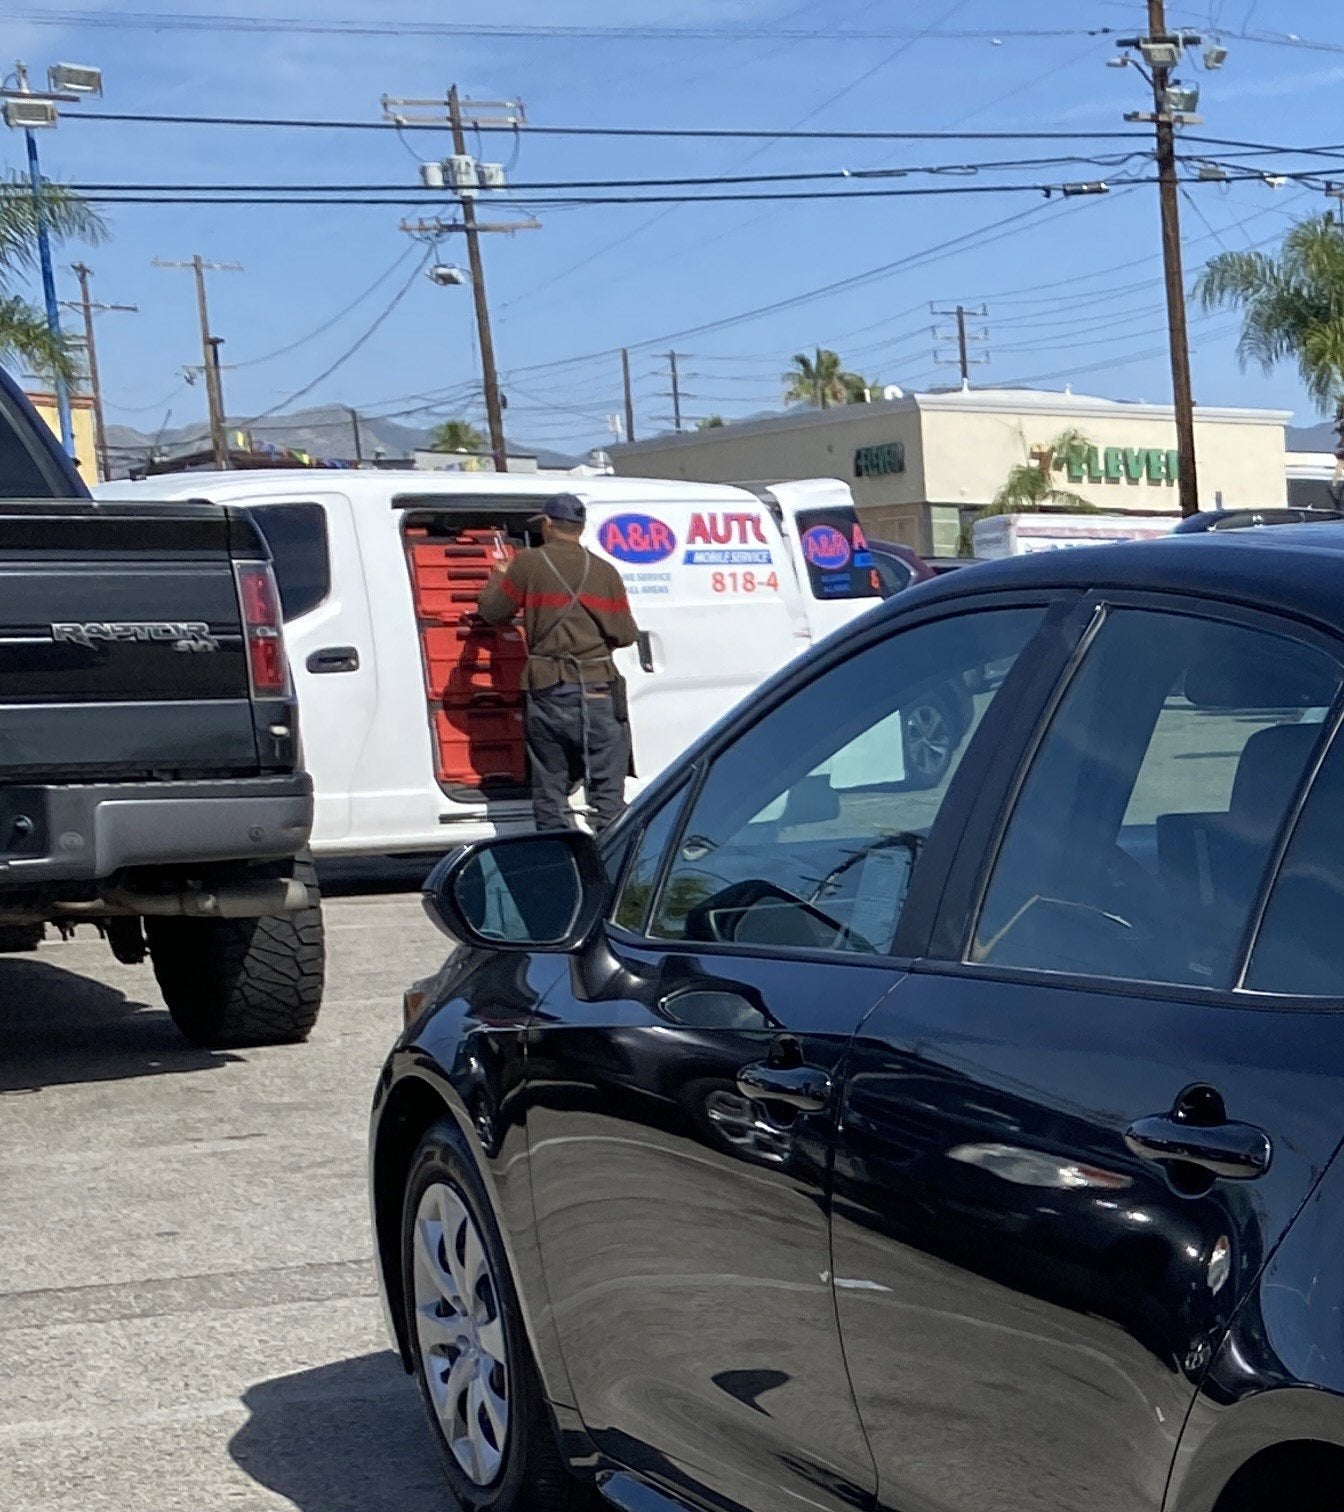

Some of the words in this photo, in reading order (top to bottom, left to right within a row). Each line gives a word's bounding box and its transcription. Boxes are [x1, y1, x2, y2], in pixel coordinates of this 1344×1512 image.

[606, 522, 674, 553] A&R
[731, 551, 769, 564] SERVICE
[50, 621, 210, 650] RAPTOR
